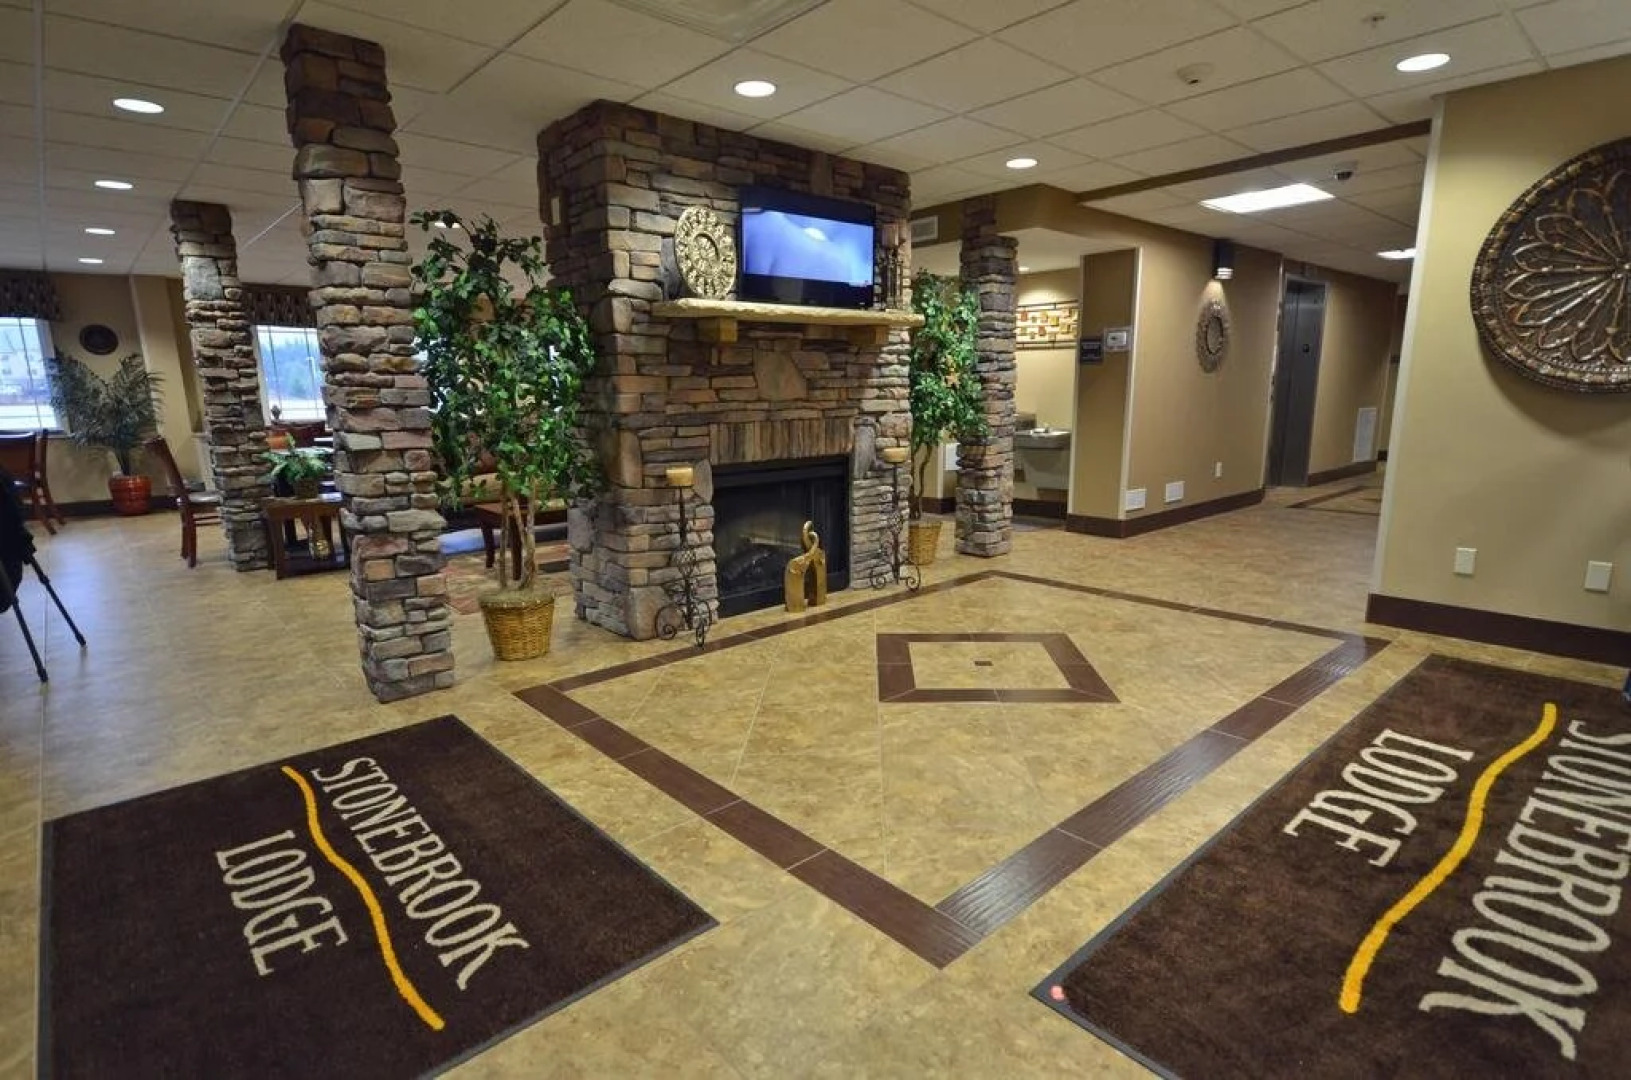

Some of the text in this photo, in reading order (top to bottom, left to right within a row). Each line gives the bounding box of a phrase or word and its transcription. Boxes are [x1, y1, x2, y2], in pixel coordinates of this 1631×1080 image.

[1284, 729, 1474, 867] LODGE
[216, 830, 347, 975] LODGE
[312, 757, 528, 990] STONEBROOK
